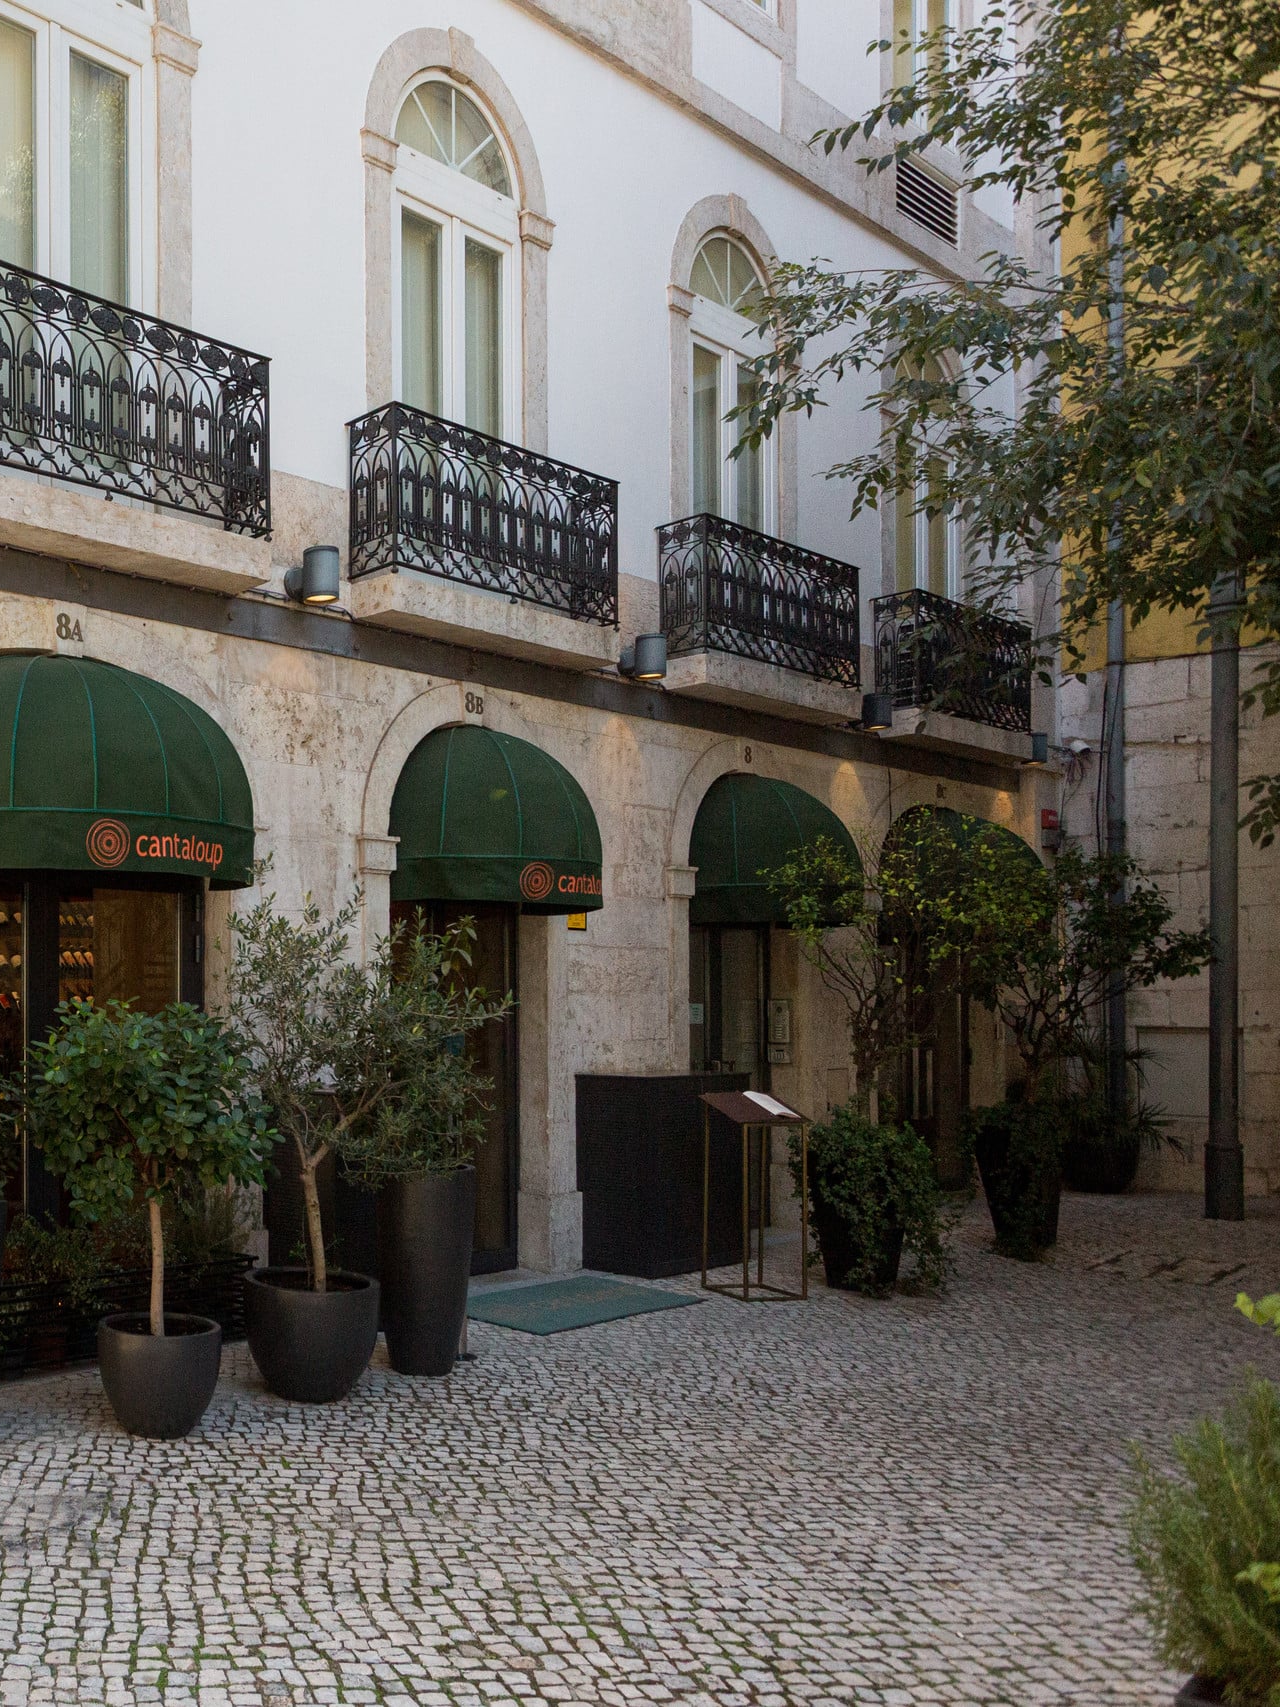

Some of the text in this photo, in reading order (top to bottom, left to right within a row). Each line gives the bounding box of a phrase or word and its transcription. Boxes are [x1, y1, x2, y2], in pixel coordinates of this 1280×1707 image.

[56, 612, 83, 642] 8A
[464, 691, 484, 715] 8B
[744, 745, 752, 764] 8
[135, 833, 223, 871] cantaloup
